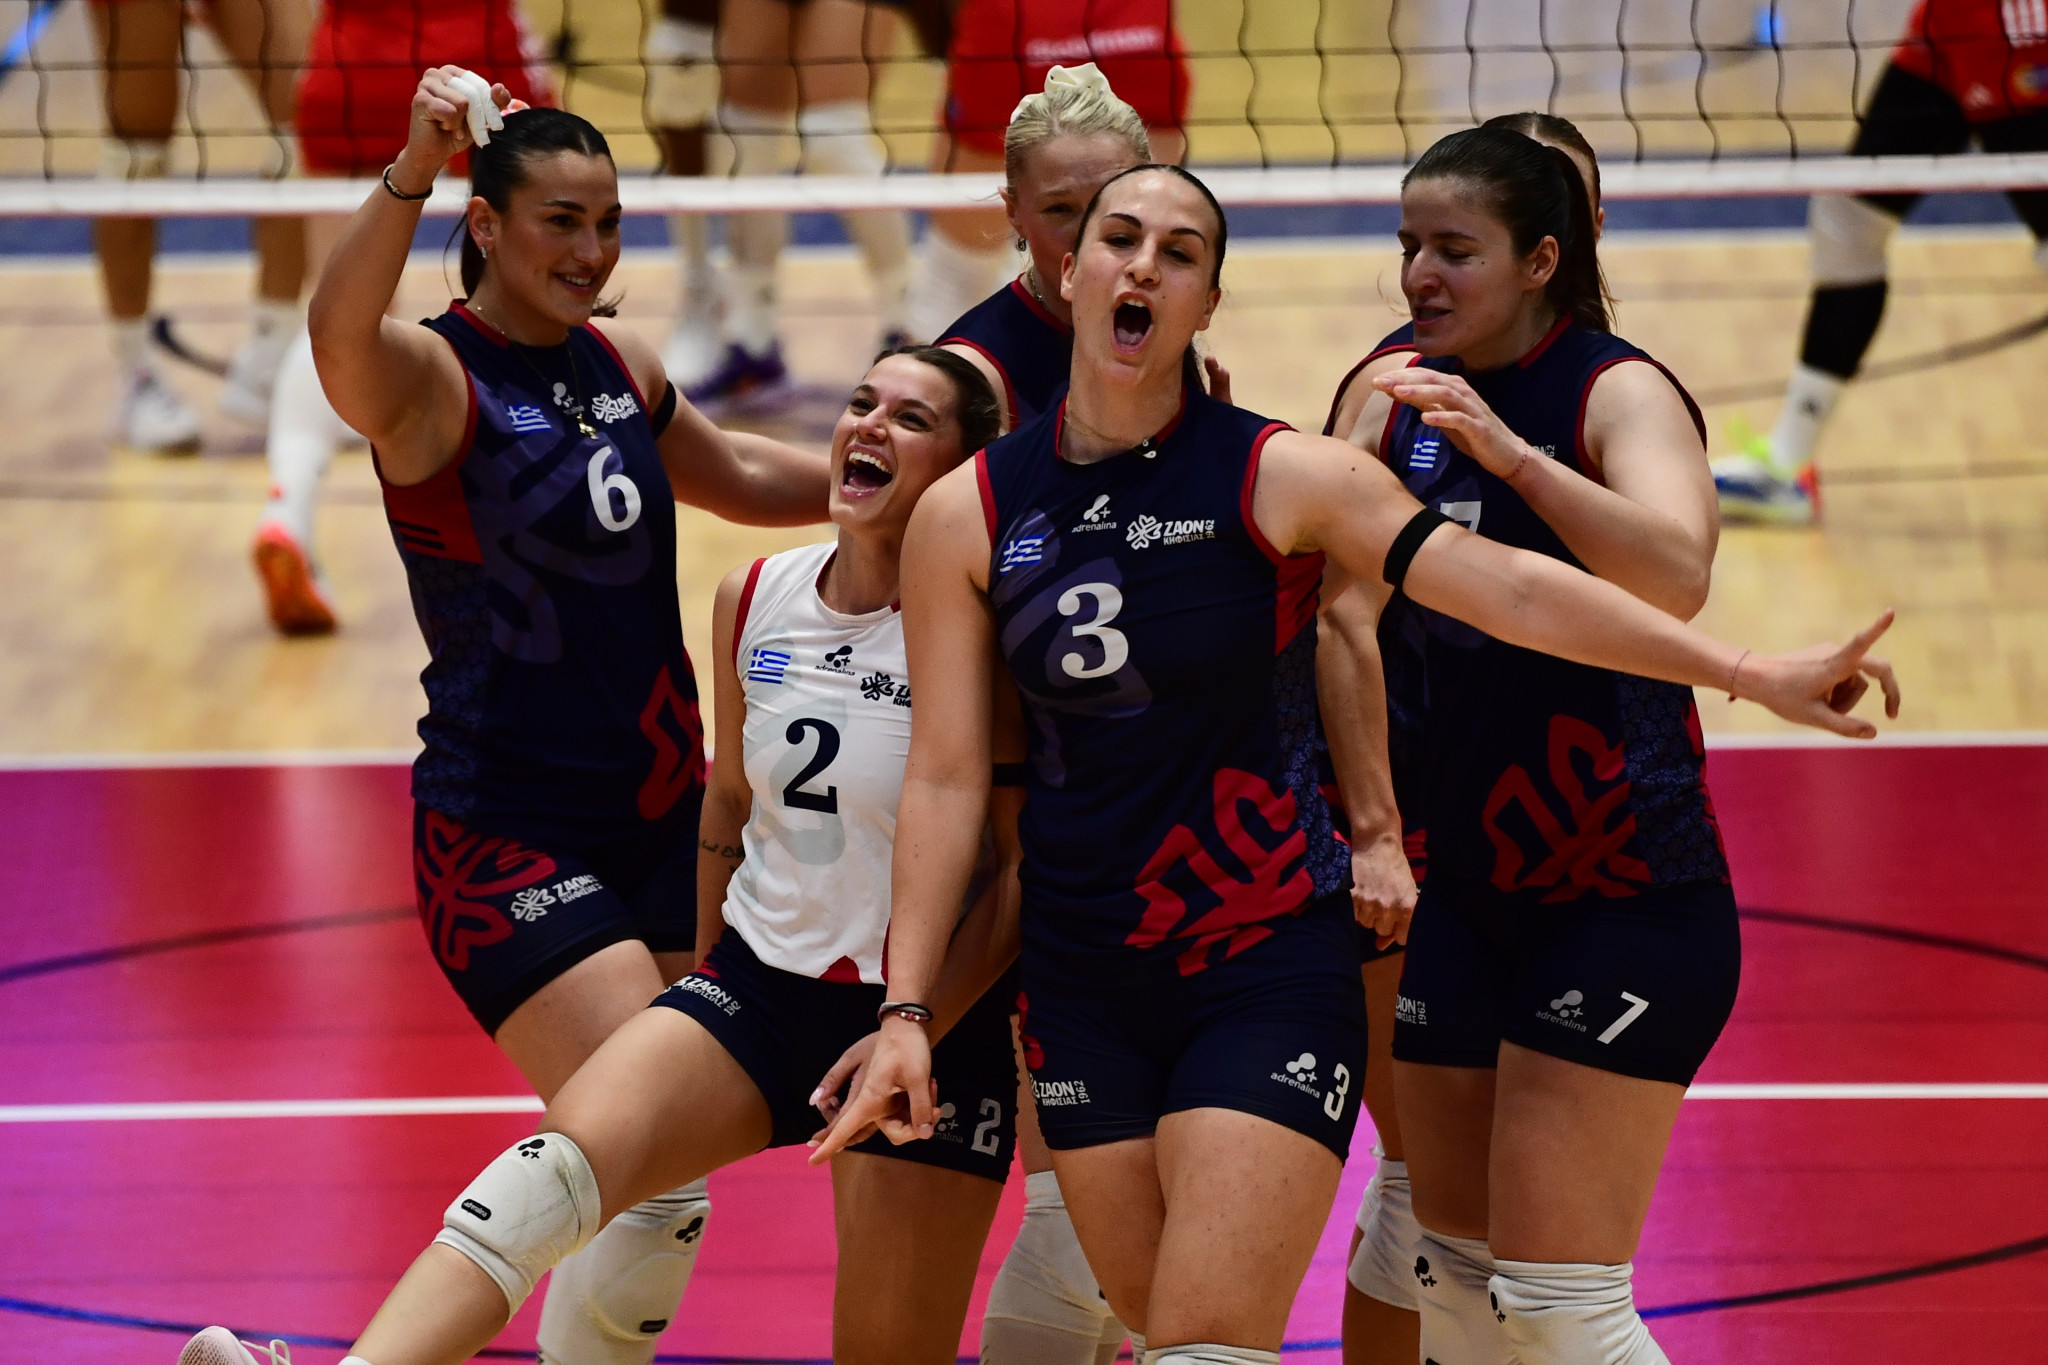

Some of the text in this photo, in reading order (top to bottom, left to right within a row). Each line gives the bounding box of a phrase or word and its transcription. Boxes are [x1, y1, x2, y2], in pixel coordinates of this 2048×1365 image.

[587, 446, 642, 532] 6
[1057, 582, 1129, 679] 3
[814, 664, 856, 677] adrenalina
[783, 717, 841, 815] 2
[1535, 1010, 1588, 1033] adrenalina
[1596, 990, 1650, 1045] 7
[1270, 1072, 1321, 1099] adrenalina
[1323, 1062, 1351, 1122] 3
[970, 1097, 1002, 1157] 2
